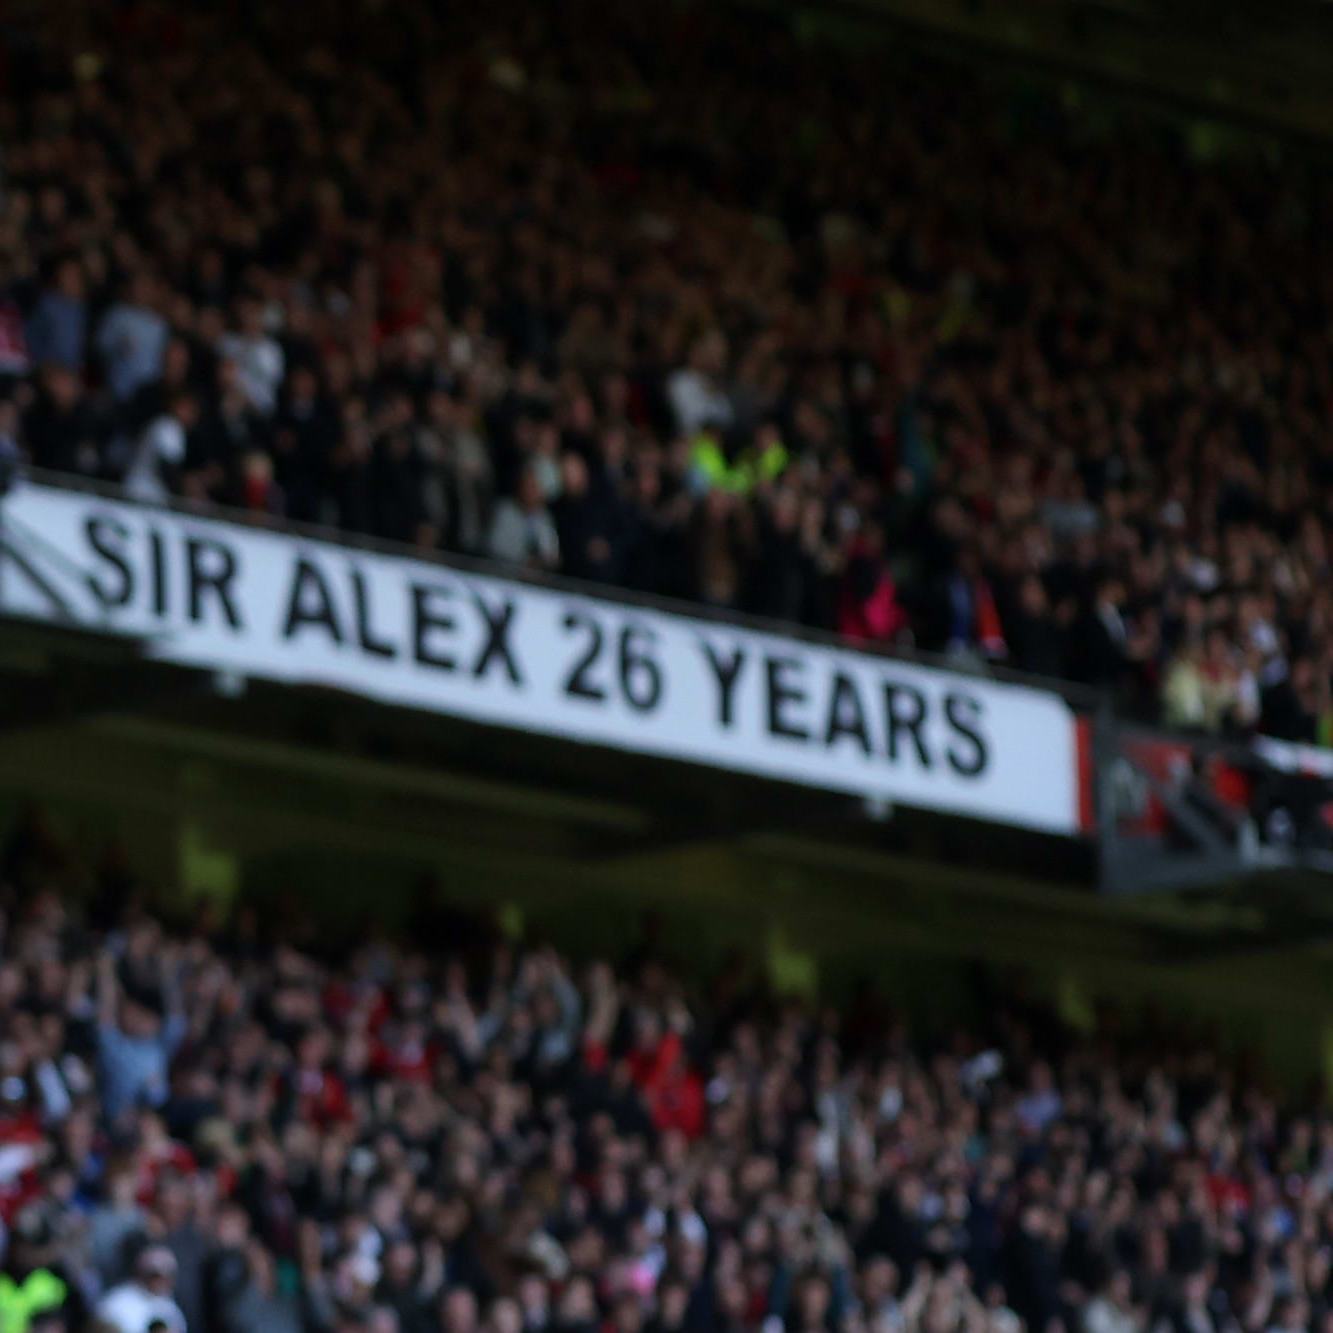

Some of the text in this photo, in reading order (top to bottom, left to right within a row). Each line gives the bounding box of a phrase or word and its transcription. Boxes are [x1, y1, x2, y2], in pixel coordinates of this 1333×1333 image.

[83, 512, 992, 780] SIR ALEX 26 YEARS
